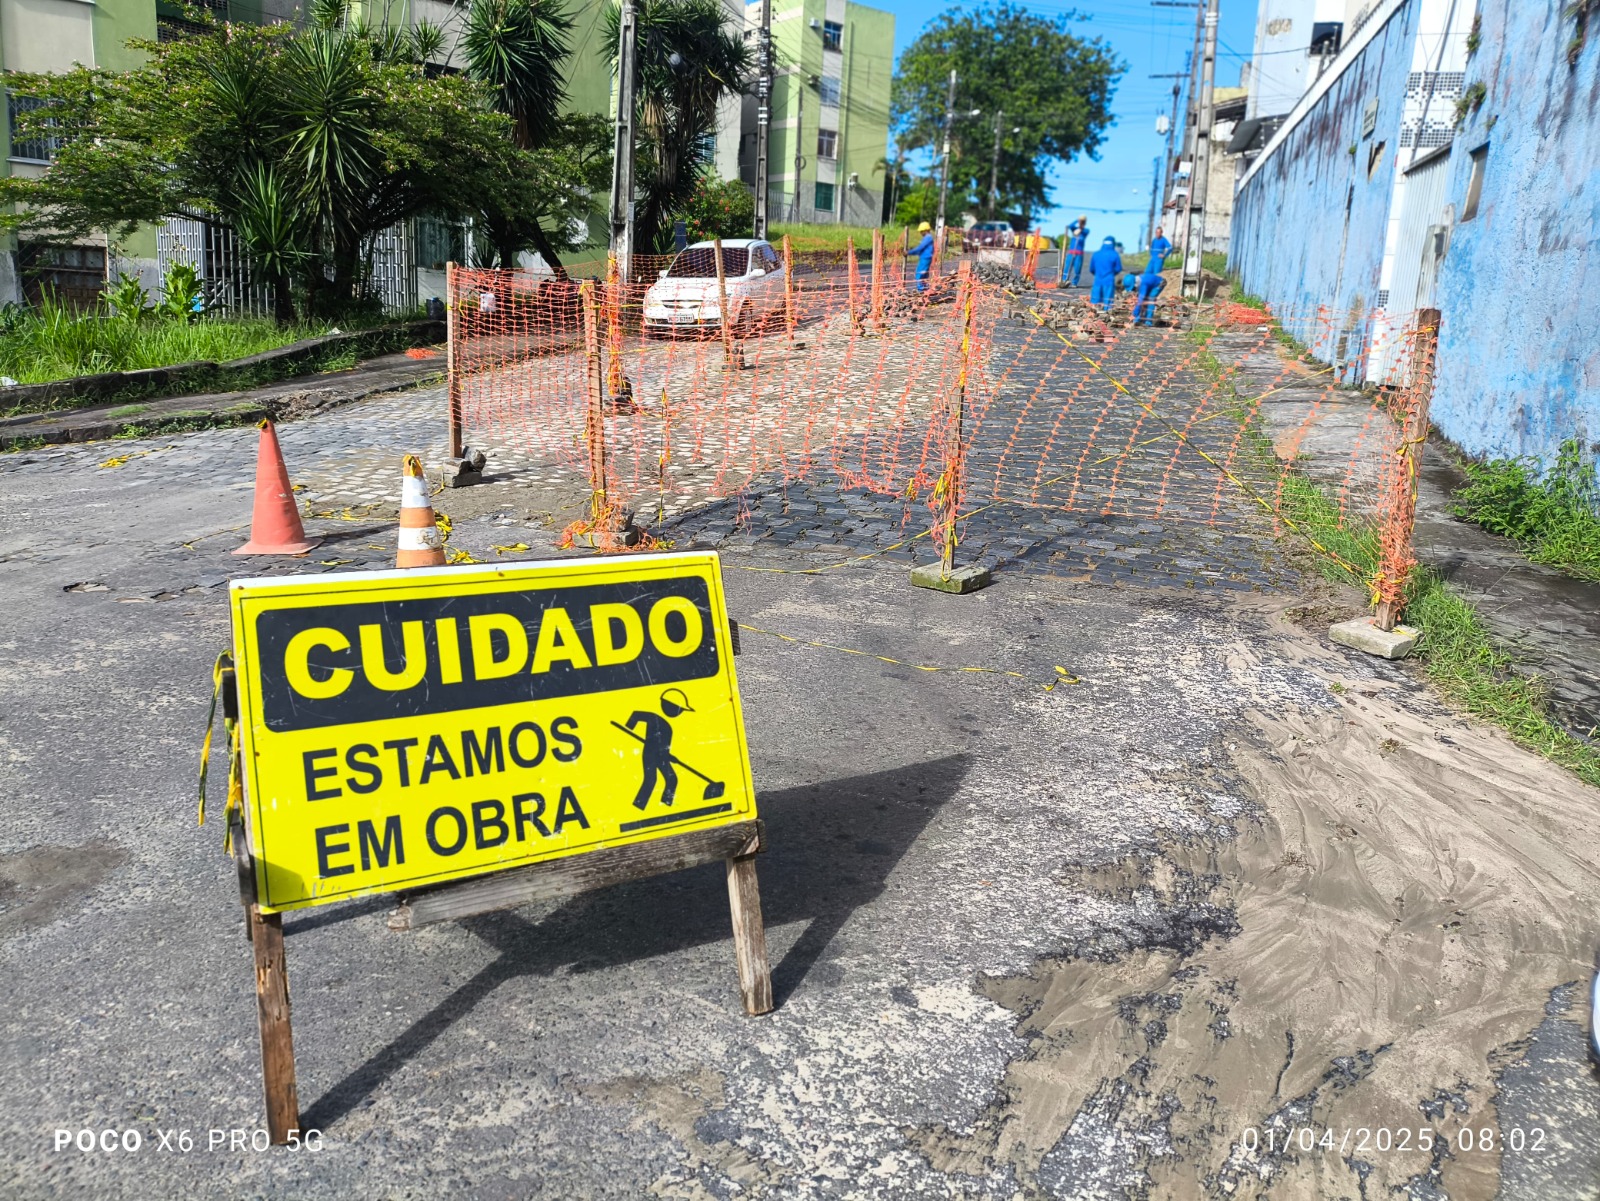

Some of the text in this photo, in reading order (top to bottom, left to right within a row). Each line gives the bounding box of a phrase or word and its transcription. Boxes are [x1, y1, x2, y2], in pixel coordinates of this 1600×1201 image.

[284, 596, 704, 699] CUIDADO
[302, 716, 583, 802] ESTAMOS
[315, 785, 590, 878] EM OBRA
